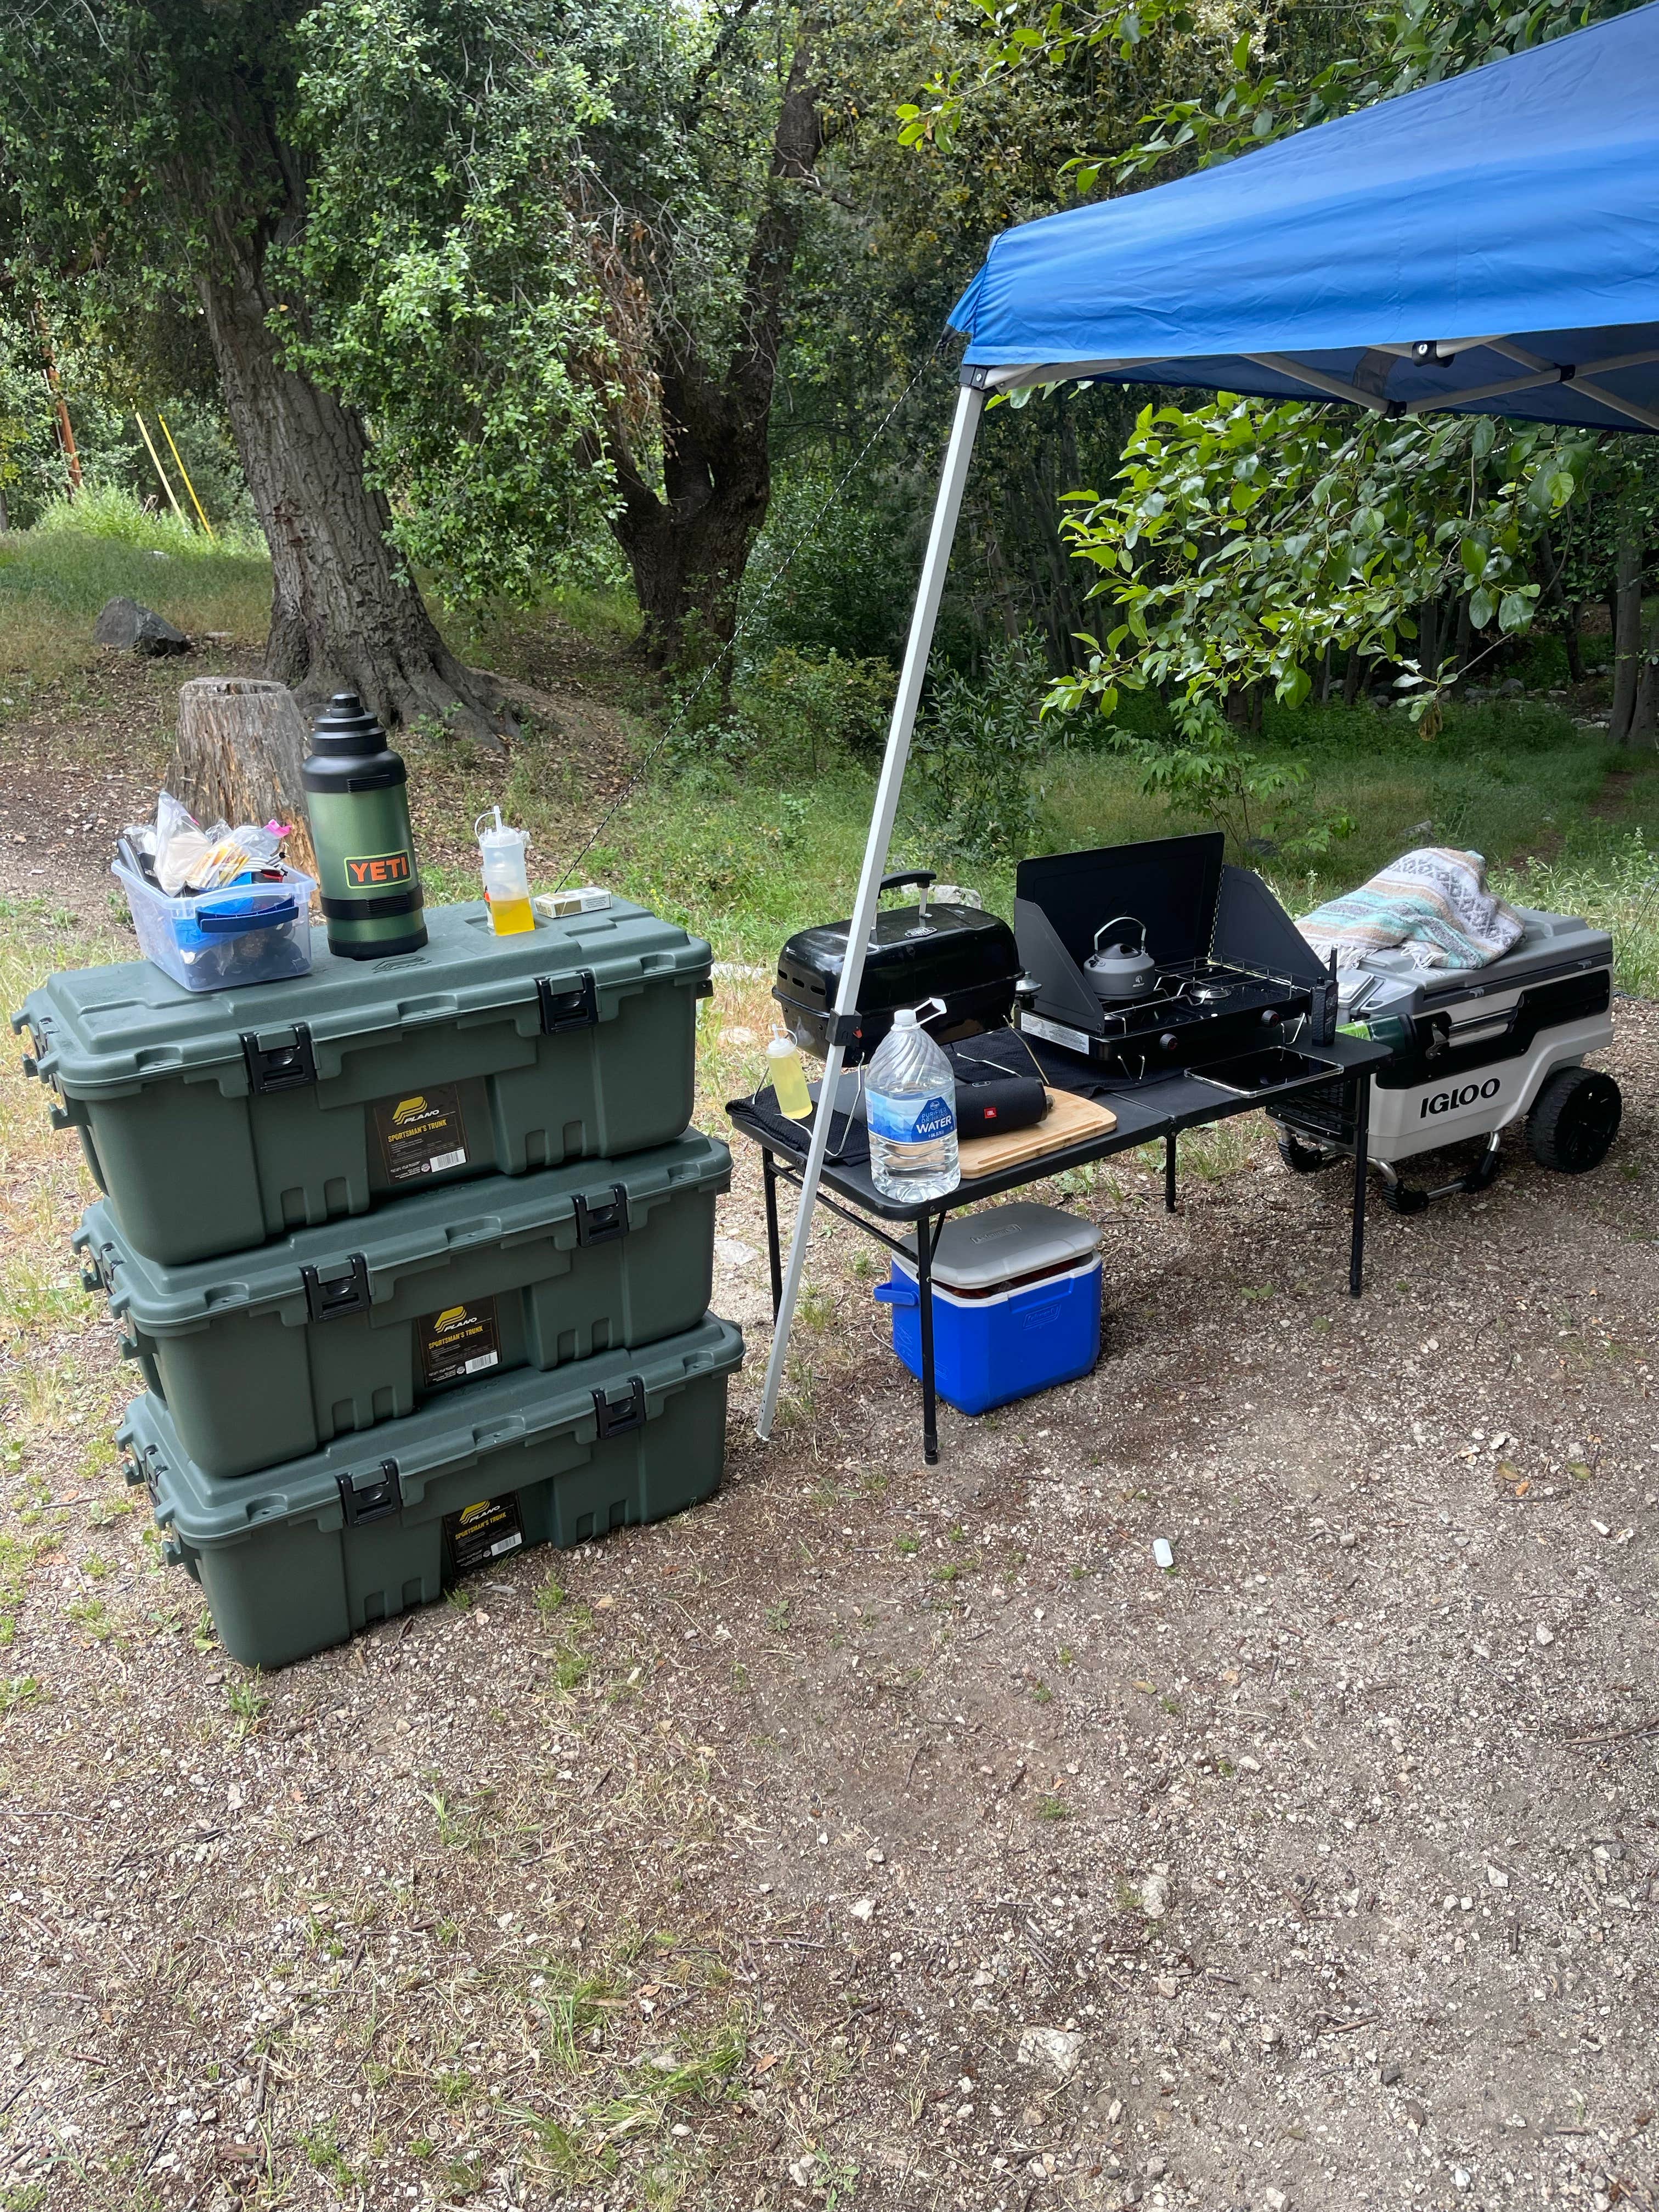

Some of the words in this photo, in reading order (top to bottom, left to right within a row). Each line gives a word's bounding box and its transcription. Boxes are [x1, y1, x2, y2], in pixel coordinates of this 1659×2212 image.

[349, 856, 408, 882] YETI
[1420, 1078, 1500, 1119] IGLOO
[404, 1109, 439, 1124] PLANO
[922, 1107, 947, 1119] PURIFIED
[922, 1111, 948, 1124] DRINKING
[387, 1125, 427, 1143] SPORTSMAN'S
[428, 1119, 447, 1130] TRUNK
[916, 1115, 952, 1134] WATER
[444, 1317, 477, 1333] PLANO
[428, 1331, 465, 1350] SPORTSMAN'S
[465, 1325, 483, 1336] TRUNK
[469, 1505, 500, 1523] PLANO
[489, 1512, 507, 1523] TRUNK
